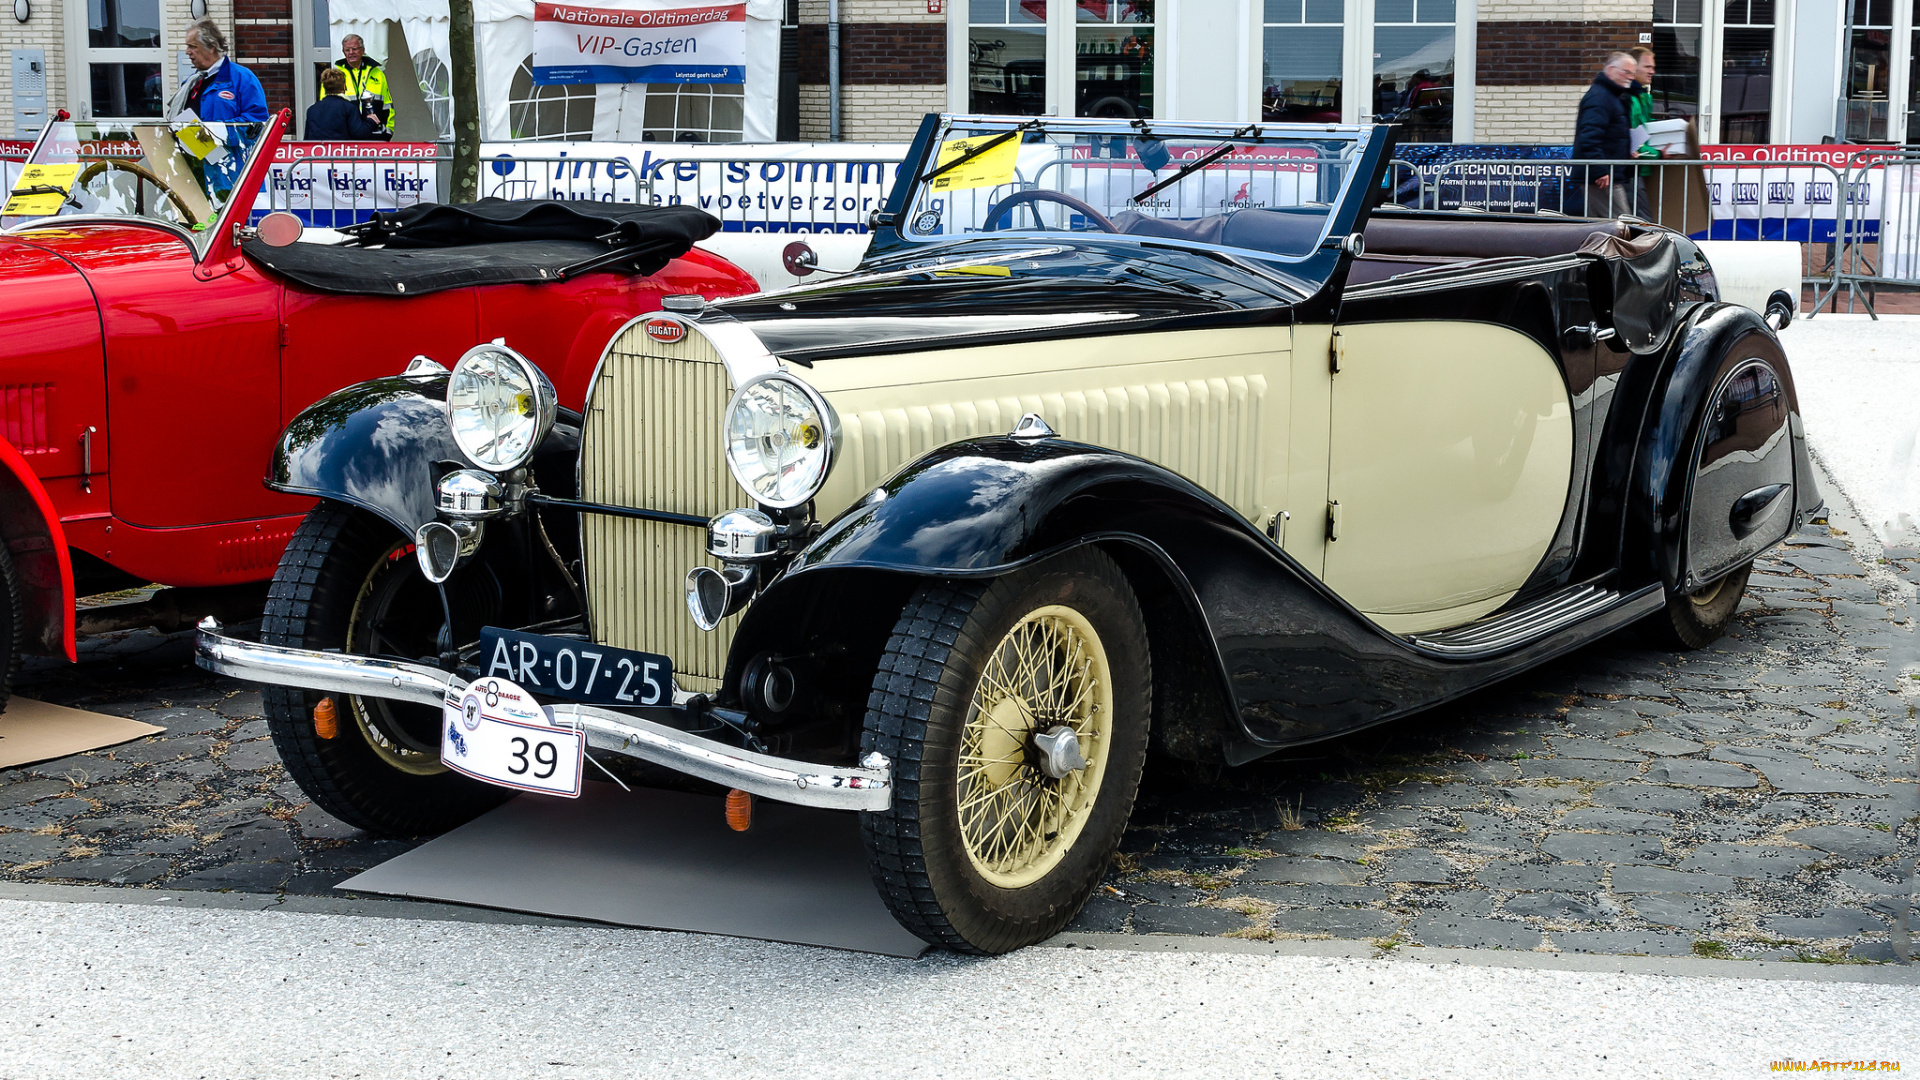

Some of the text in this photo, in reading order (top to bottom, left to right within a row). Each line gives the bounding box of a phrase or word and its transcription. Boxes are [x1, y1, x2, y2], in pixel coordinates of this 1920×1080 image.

[552, 7, 730, 25] Nationale Oldtimerdag
[576, 33, 698, 57] VIP-Gasten
[310, 143, 436, 162] Oldtimerdag
[384, 168, 429, 191] Fisher
[726, 160, 904, 184] somm
[1806, 183, 1832, 201] FEVO
[647, 324, 680, 337] BUGATTI
[507, 736, 558, 780] 39
